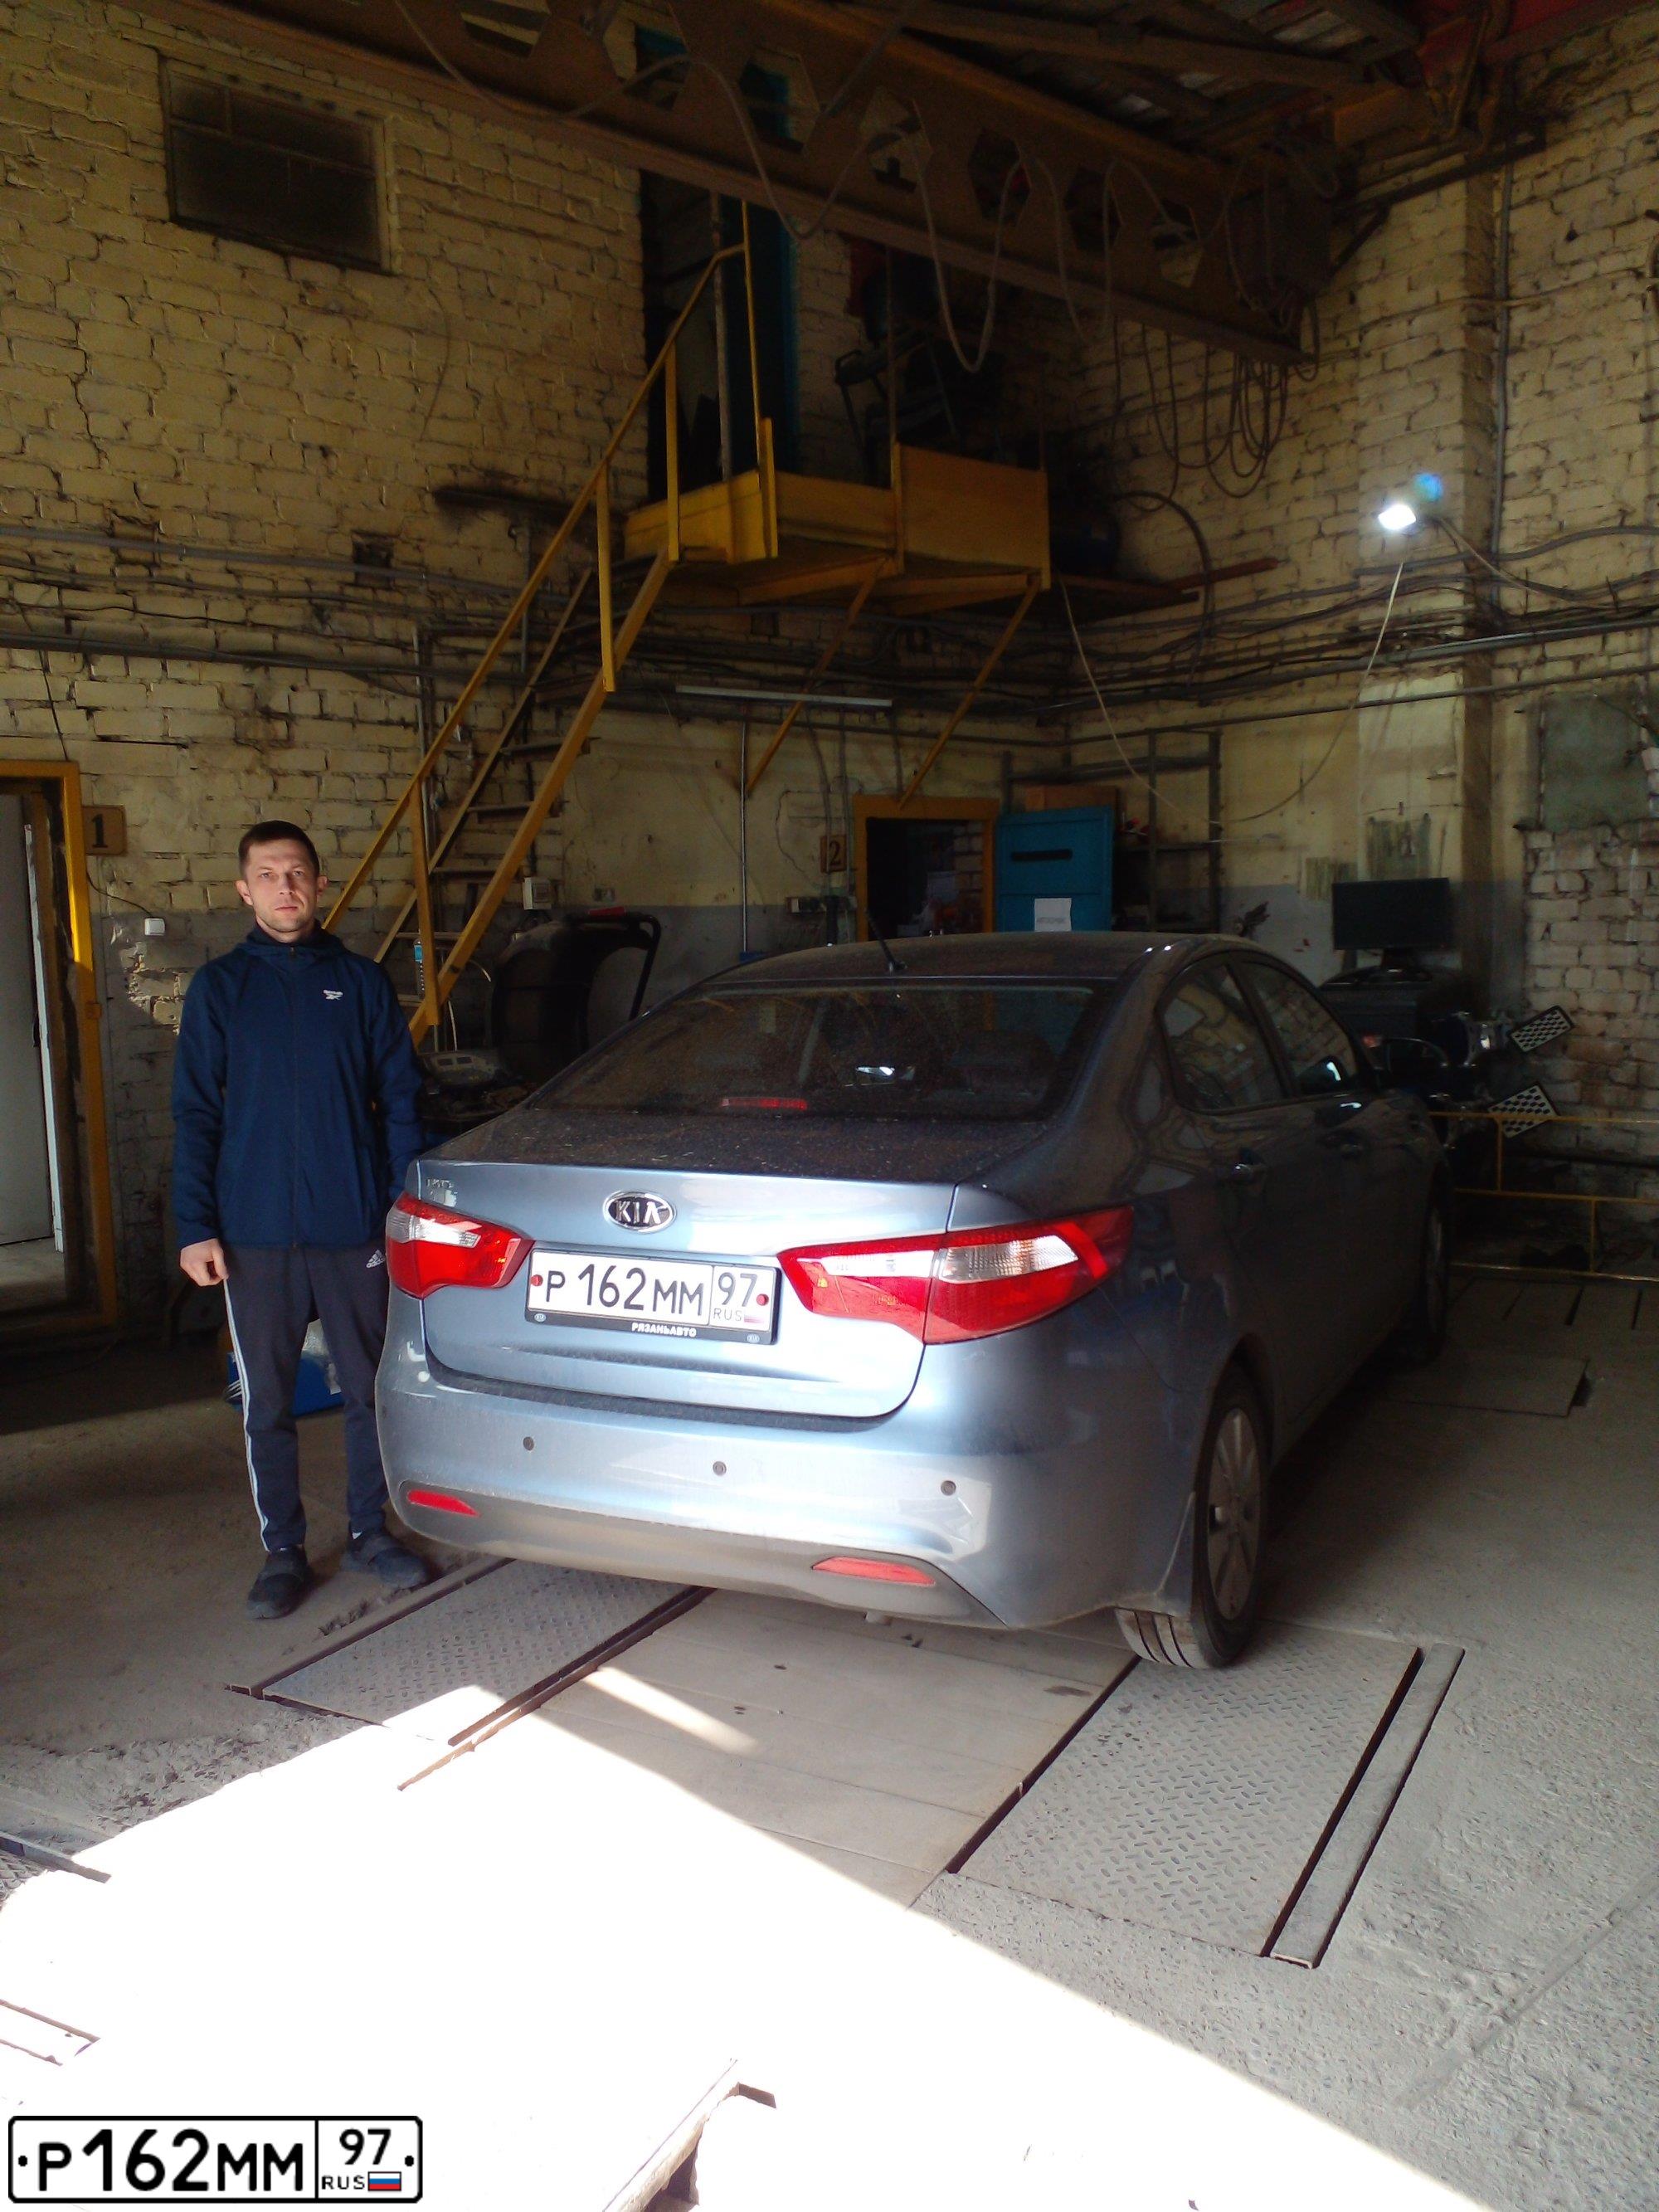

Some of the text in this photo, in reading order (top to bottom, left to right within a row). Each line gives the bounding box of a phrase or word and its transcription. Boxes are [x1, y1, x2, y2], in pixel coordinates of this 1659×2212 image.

[92, 814, 108, 848] 1
[830, 840, 841, 865] 2
[615, 1200, 662, 1224] KIA
[718, 1272, 758, 1307] 97
[713, 1308, 742, 1322] RUS
[631, 1323, 697, 1337] РЯЗАНЬАВТО
